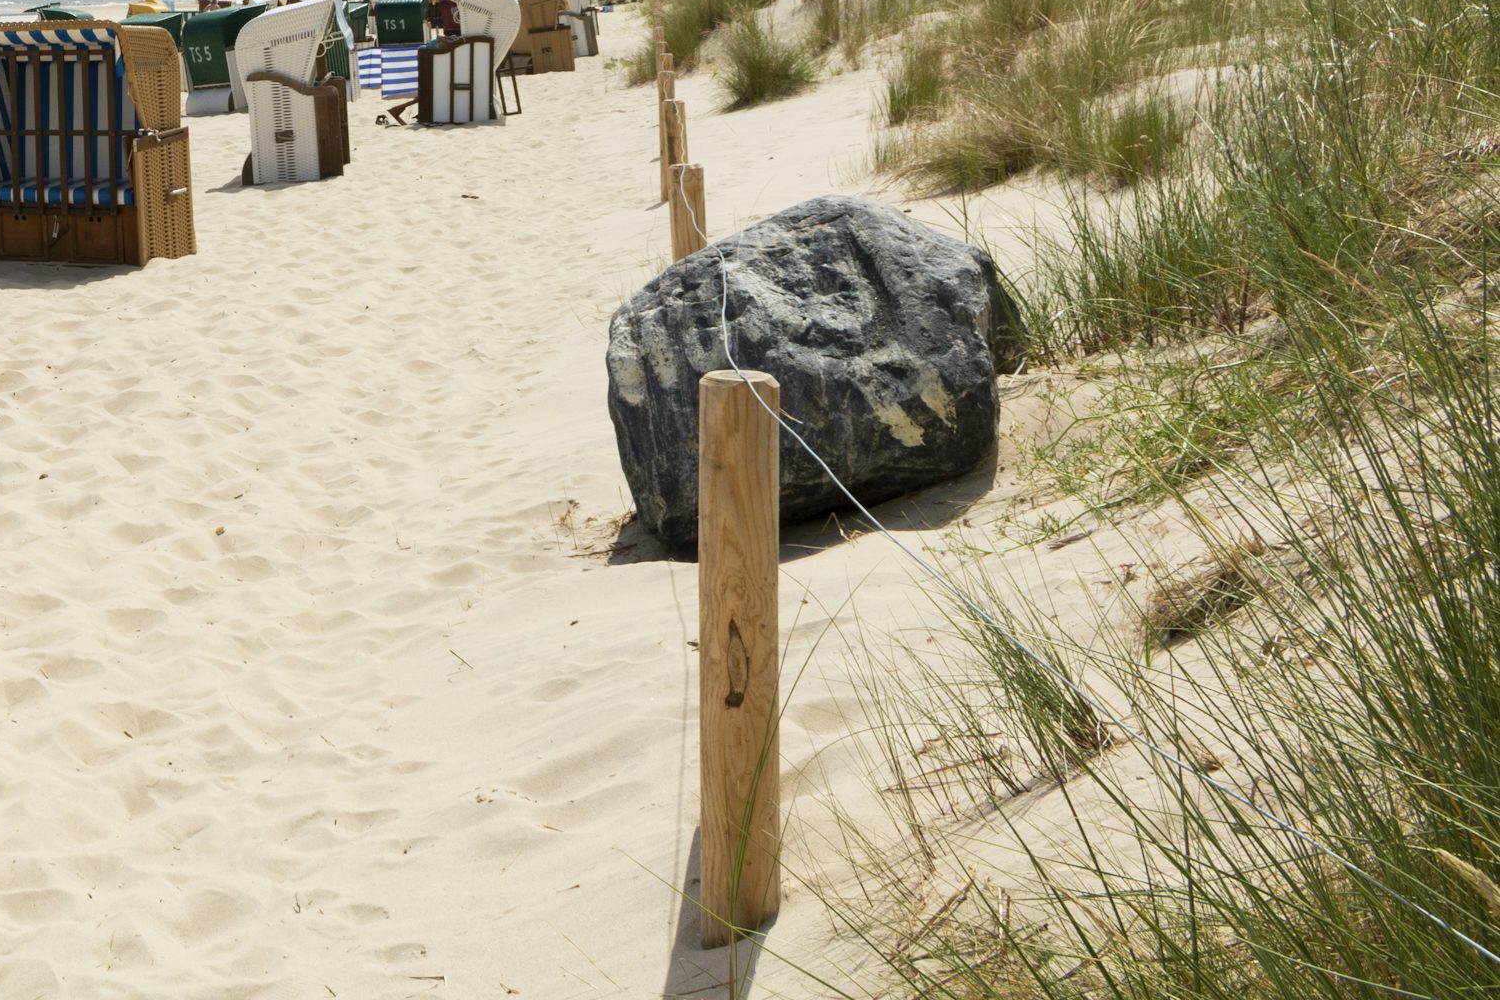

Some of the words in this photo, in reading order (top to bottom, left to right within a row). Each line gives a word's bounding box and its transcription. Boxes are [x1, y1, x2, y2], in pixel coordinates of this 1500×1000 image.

[383, 19, 397, 31] TS
[399, 18, 406, 31] 1
[188, 46, 203, 63] TS
[203, 45, 212, 62] 5
